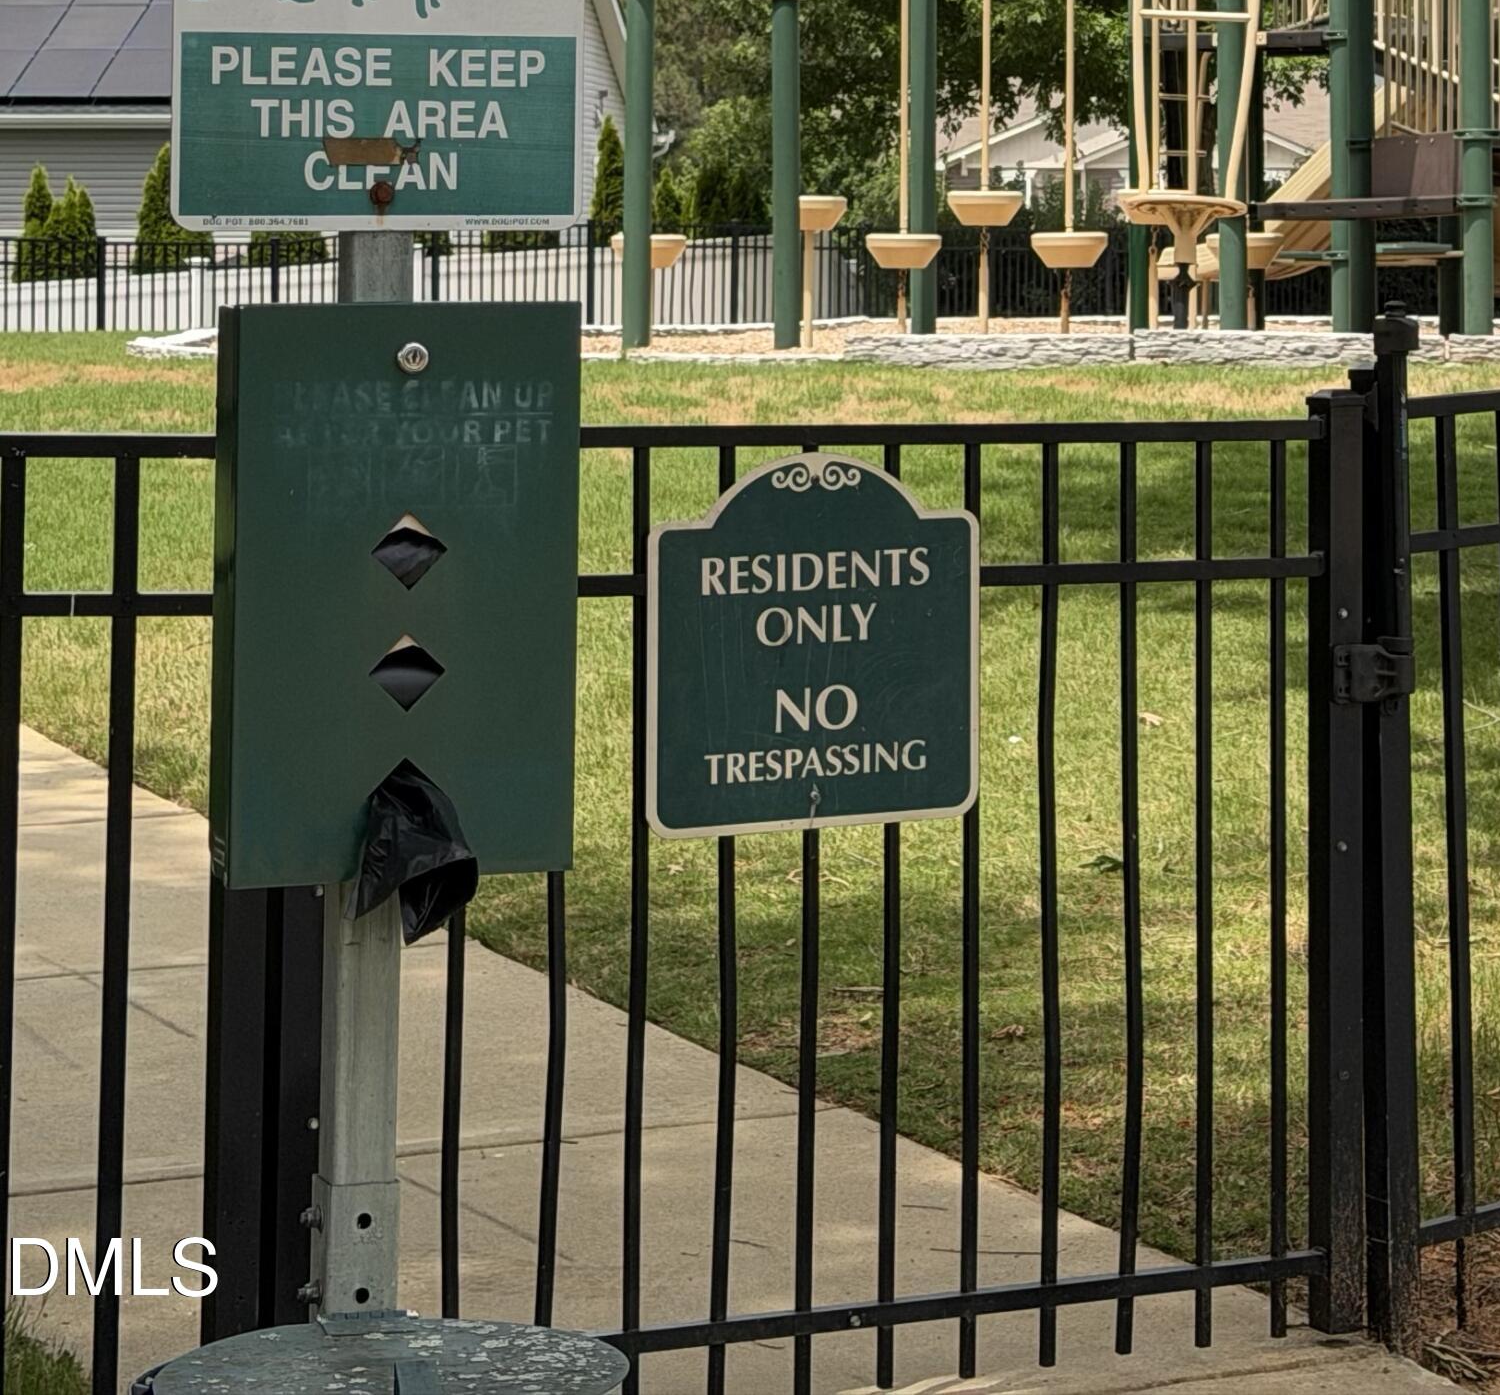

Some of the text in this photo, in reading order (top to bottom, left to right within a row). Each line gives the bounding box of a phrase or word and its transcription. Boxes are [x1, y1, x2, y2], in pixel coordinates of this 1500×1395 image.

[211, 45, 546, 88] PLEASE KEEP
[250, 98, 508, 139] THIS AREA
[304, 151, 458, 191] CLEAN
[513, 380, 554, 409] UP
[493, 418, 552, 444] PET
[701, 546, 931, 596] RESIDENTS
[756, 602, 878, 647] ONLY
[774, 683, 859, 734] NO
[703, 739, 927, 785] TRESPASSING
